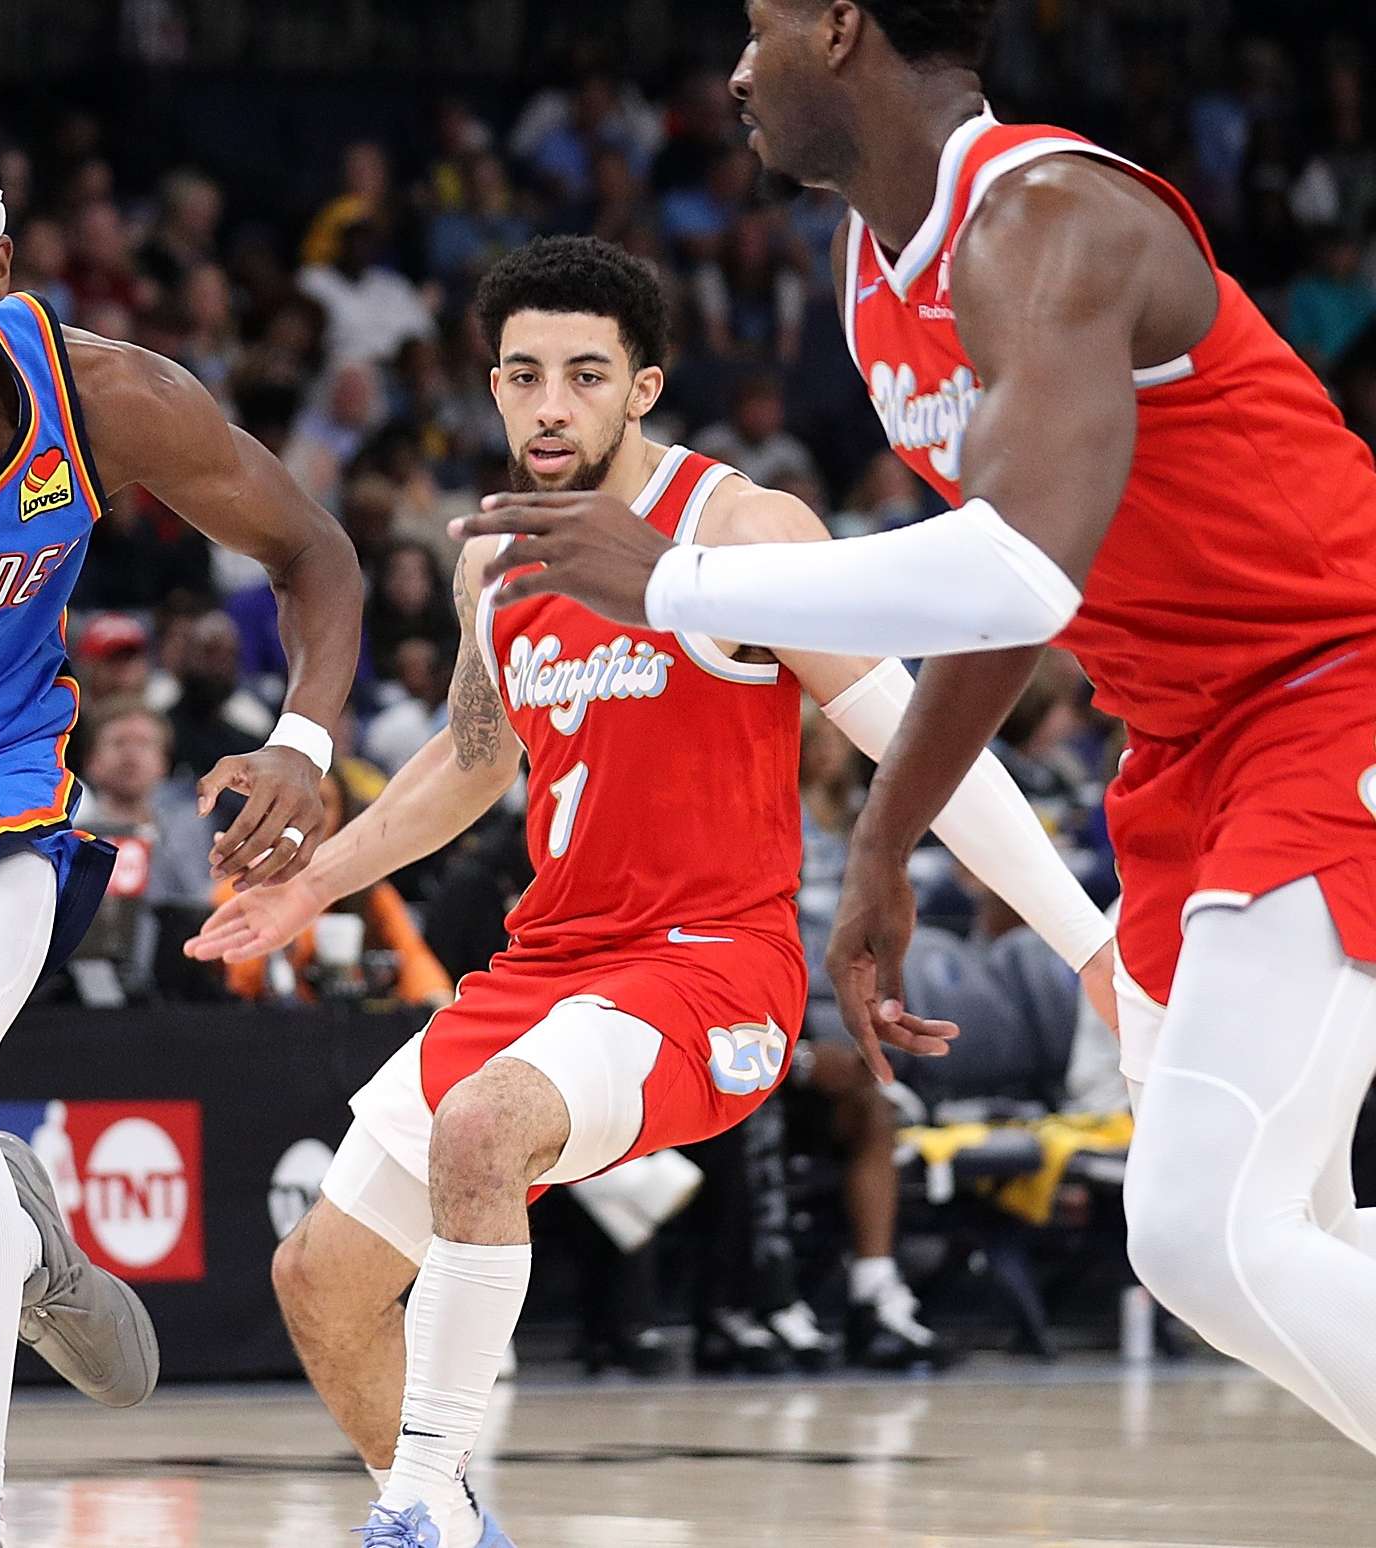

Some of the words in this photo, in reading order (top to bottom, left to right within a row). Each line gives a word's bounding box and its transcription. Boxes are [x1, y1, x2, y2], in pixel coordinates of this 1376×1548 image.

[503, 634, 674, 736] Memphis
[548, 761, 589, 859] 1
[85, 1171, 185, 1220] TNT
